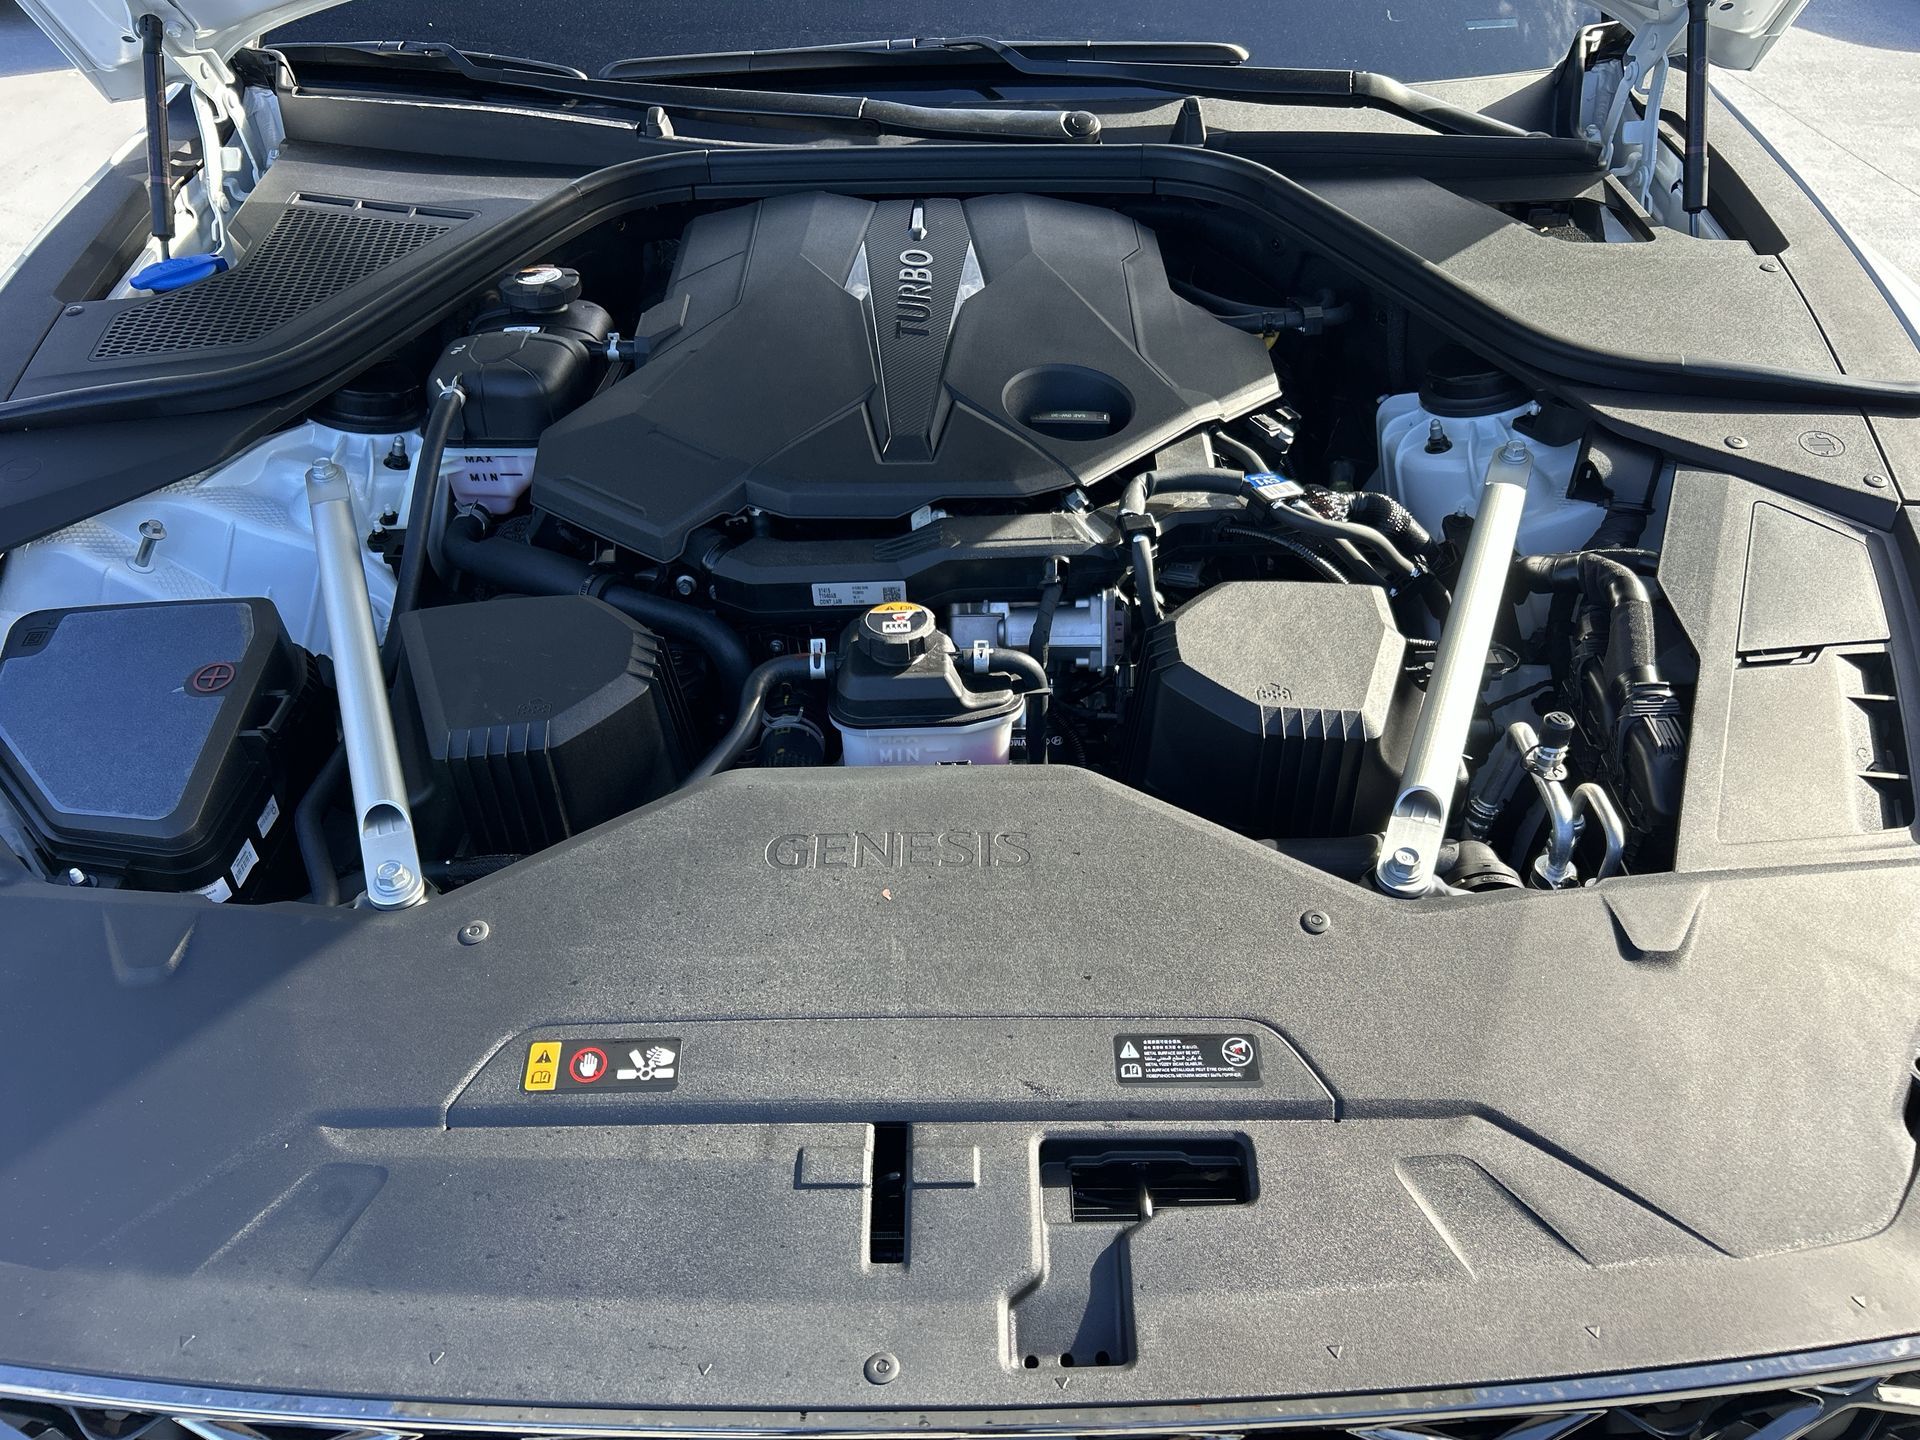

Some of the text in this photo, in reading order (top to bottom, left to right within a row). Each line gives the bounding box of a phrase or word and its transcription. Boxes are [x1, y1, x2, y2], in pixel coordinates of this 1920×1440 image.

[895, 249, 934, 339] TURBO
[464, 455, 493, 463] MAX
[469, 473, 499, 482] MIN
[879, 748, 920, 763] MIN
[764, 831, 1031, 870] GENESIS
